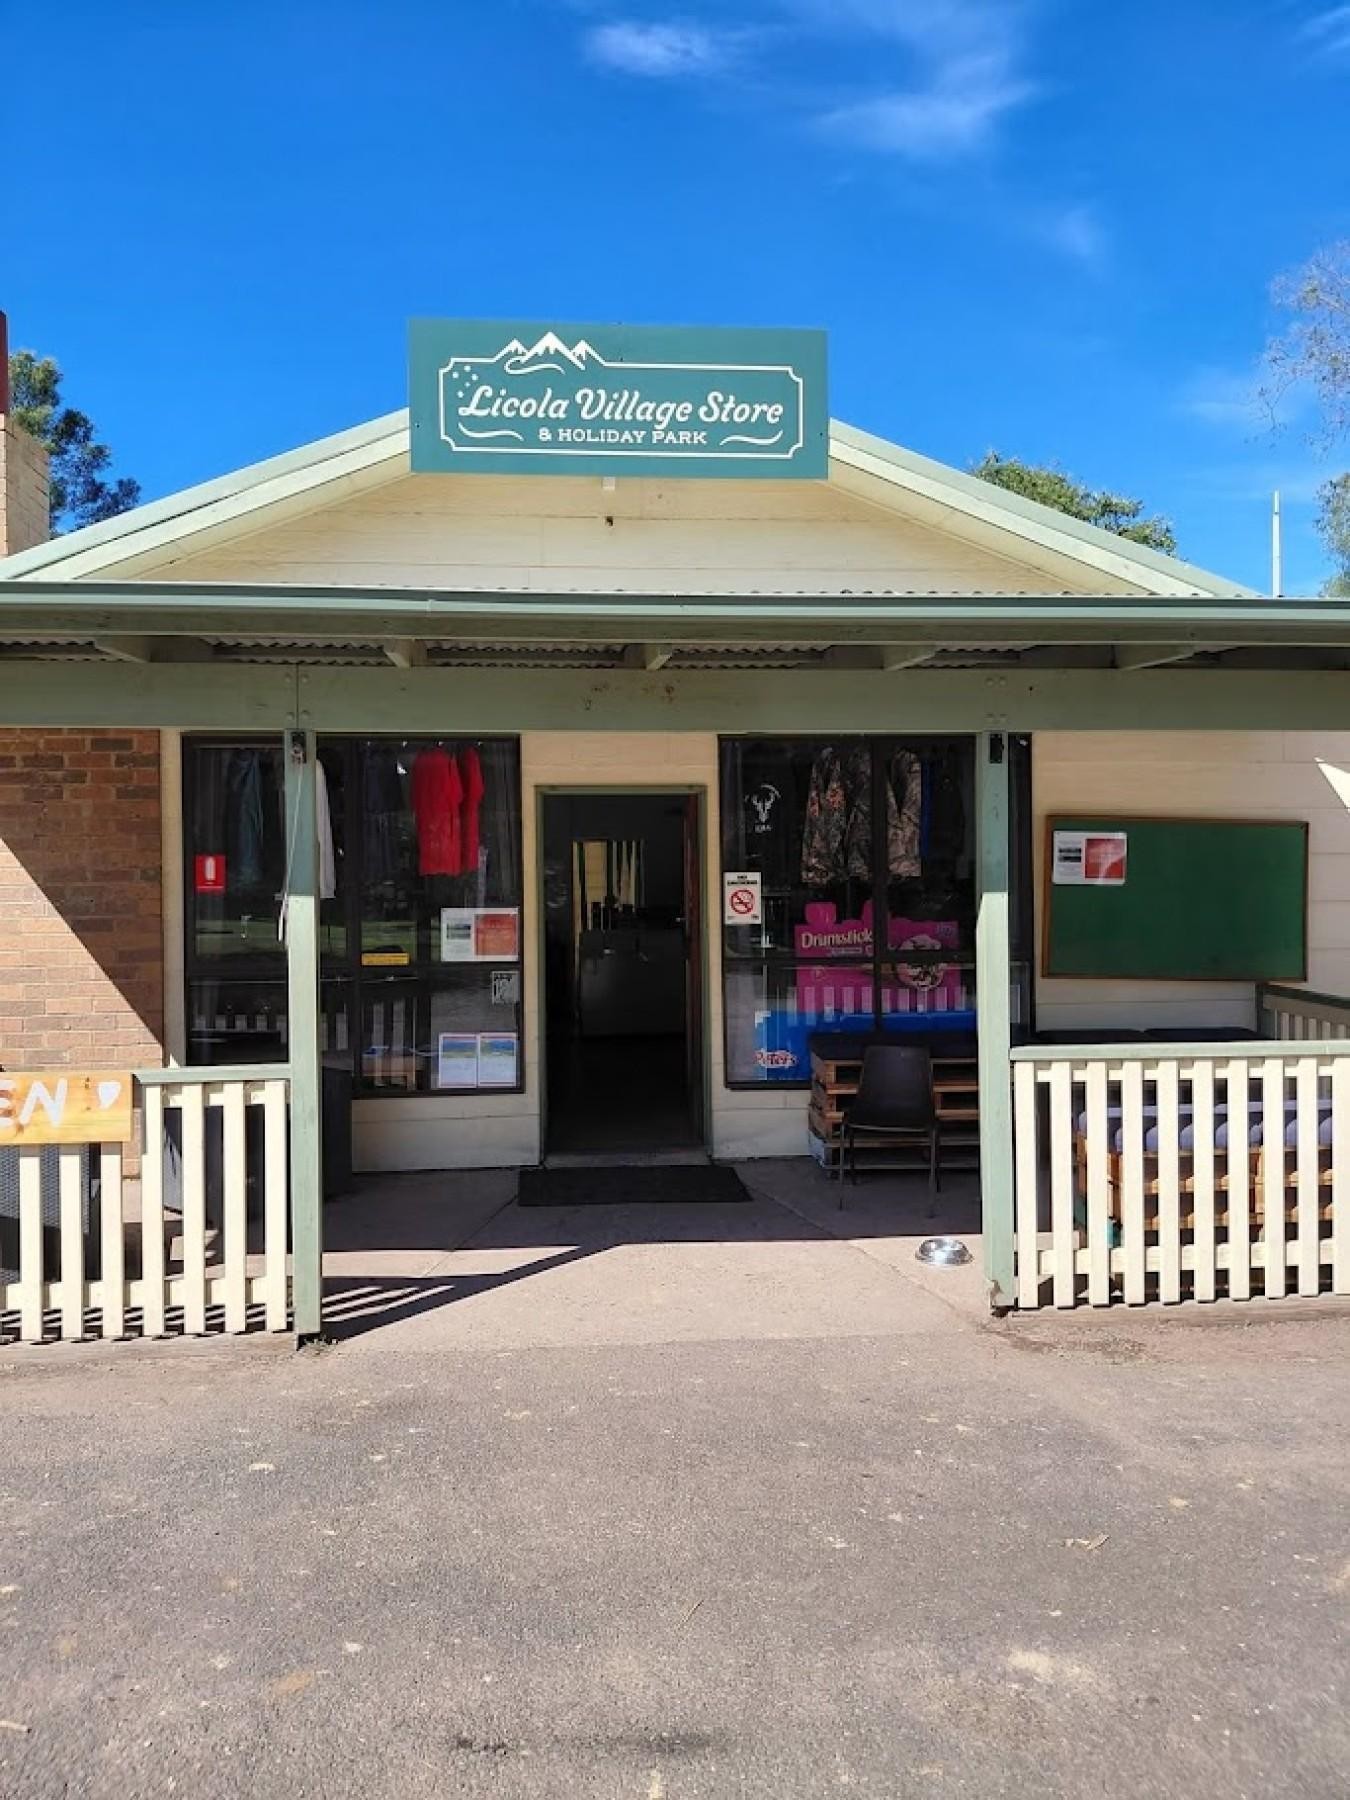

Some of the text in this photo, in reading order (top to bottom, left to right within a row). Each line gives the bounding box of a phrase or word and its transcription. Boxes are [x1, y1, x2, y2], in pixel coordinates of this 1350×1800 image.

[458, 385, 783, 430] Licola Village Store
[538, 426, 708, 444] & HOLIDAY PARK
[801, 927, 873, 949] Drumstick
